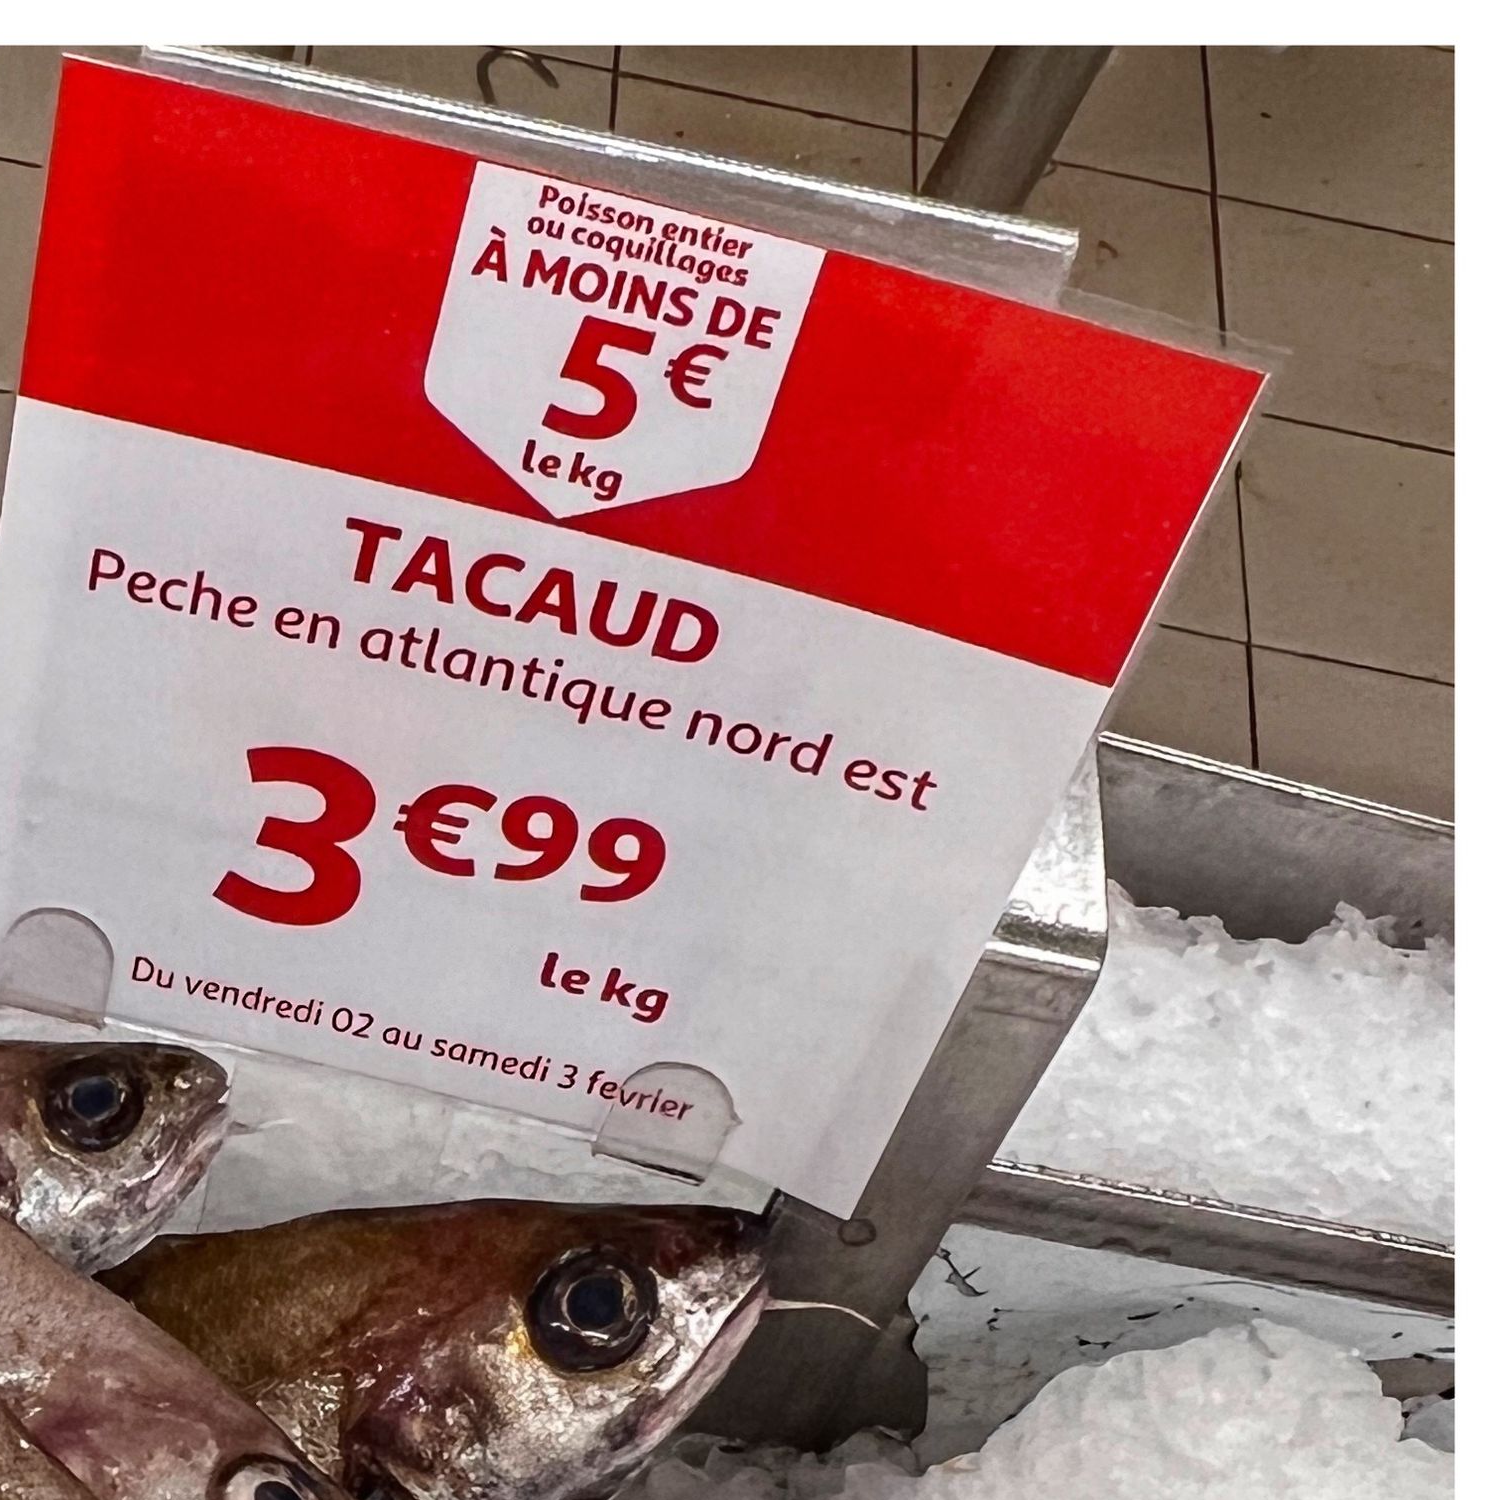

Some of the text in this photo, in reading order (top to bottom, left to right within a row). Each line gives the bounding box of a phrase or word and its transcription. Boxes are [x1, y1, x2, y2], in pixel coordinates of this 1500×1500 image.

[527, 216, 750, 287] ou coquillages
[538, 184, 754, 259] Poisson entier
[470, 225, 782, 350] À MOINS DE
[521, 438, 623, 502] le kg
[345, 516, 720, 664] TACAUD
[88, 548, 938, 811] Peche en atlantique nord est
[540, 951, 669, 1024] le kg
[131, 955, 695, 1121] Du vendredi 02 au samedi 3 fevrier
